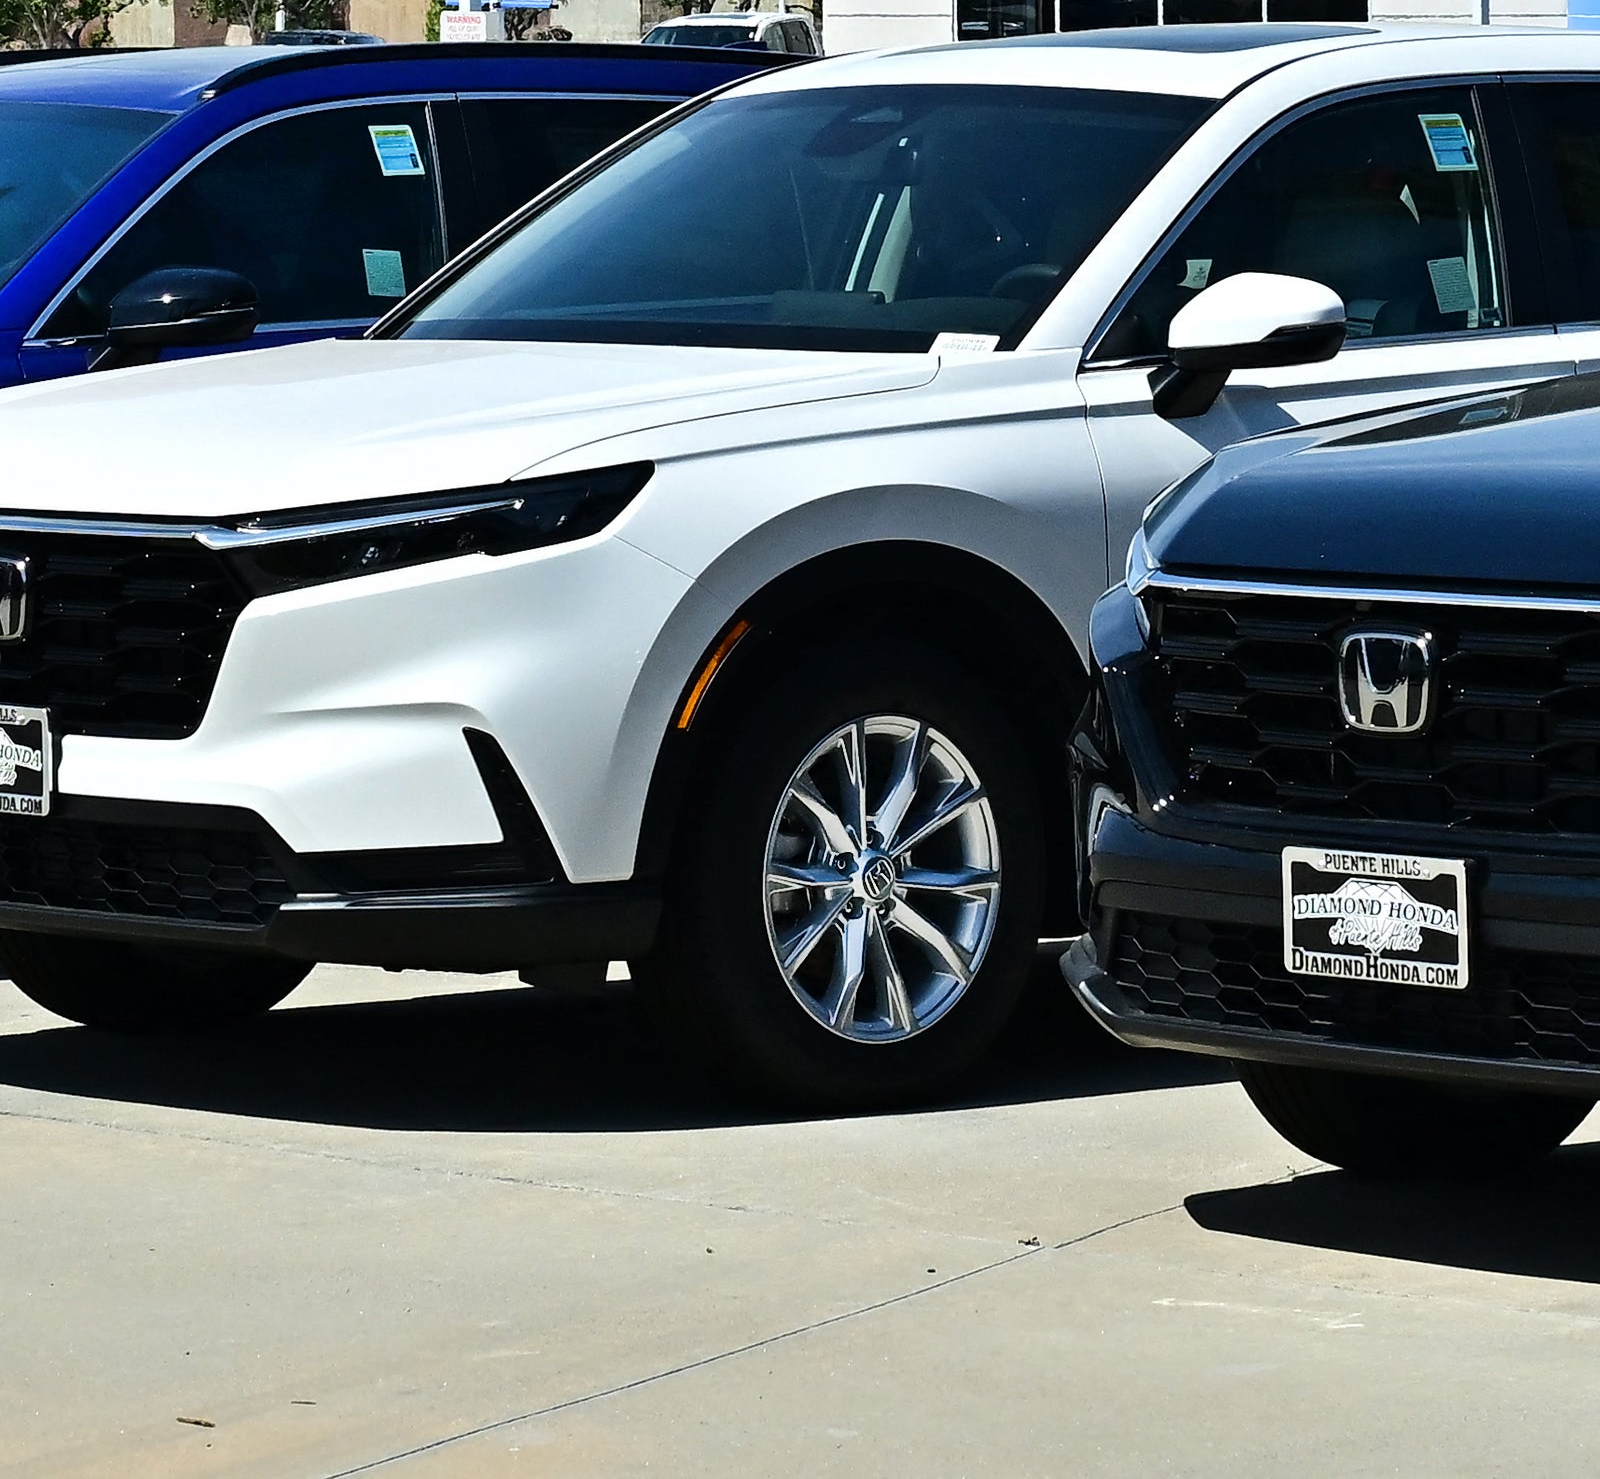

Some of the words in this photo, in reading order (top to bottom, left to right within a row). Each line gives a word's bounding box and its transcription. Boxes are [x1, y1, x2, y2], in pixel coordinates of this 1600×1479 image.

[446, 15, 481, 24] WARNING
[1324, 853, 1377, 872] PUENTE
[1381, 858, 1421, 876] HILLS
[1296, 897, 1382, 916] DIAMOND
[1388, 901, 1458, 930] HONDA
